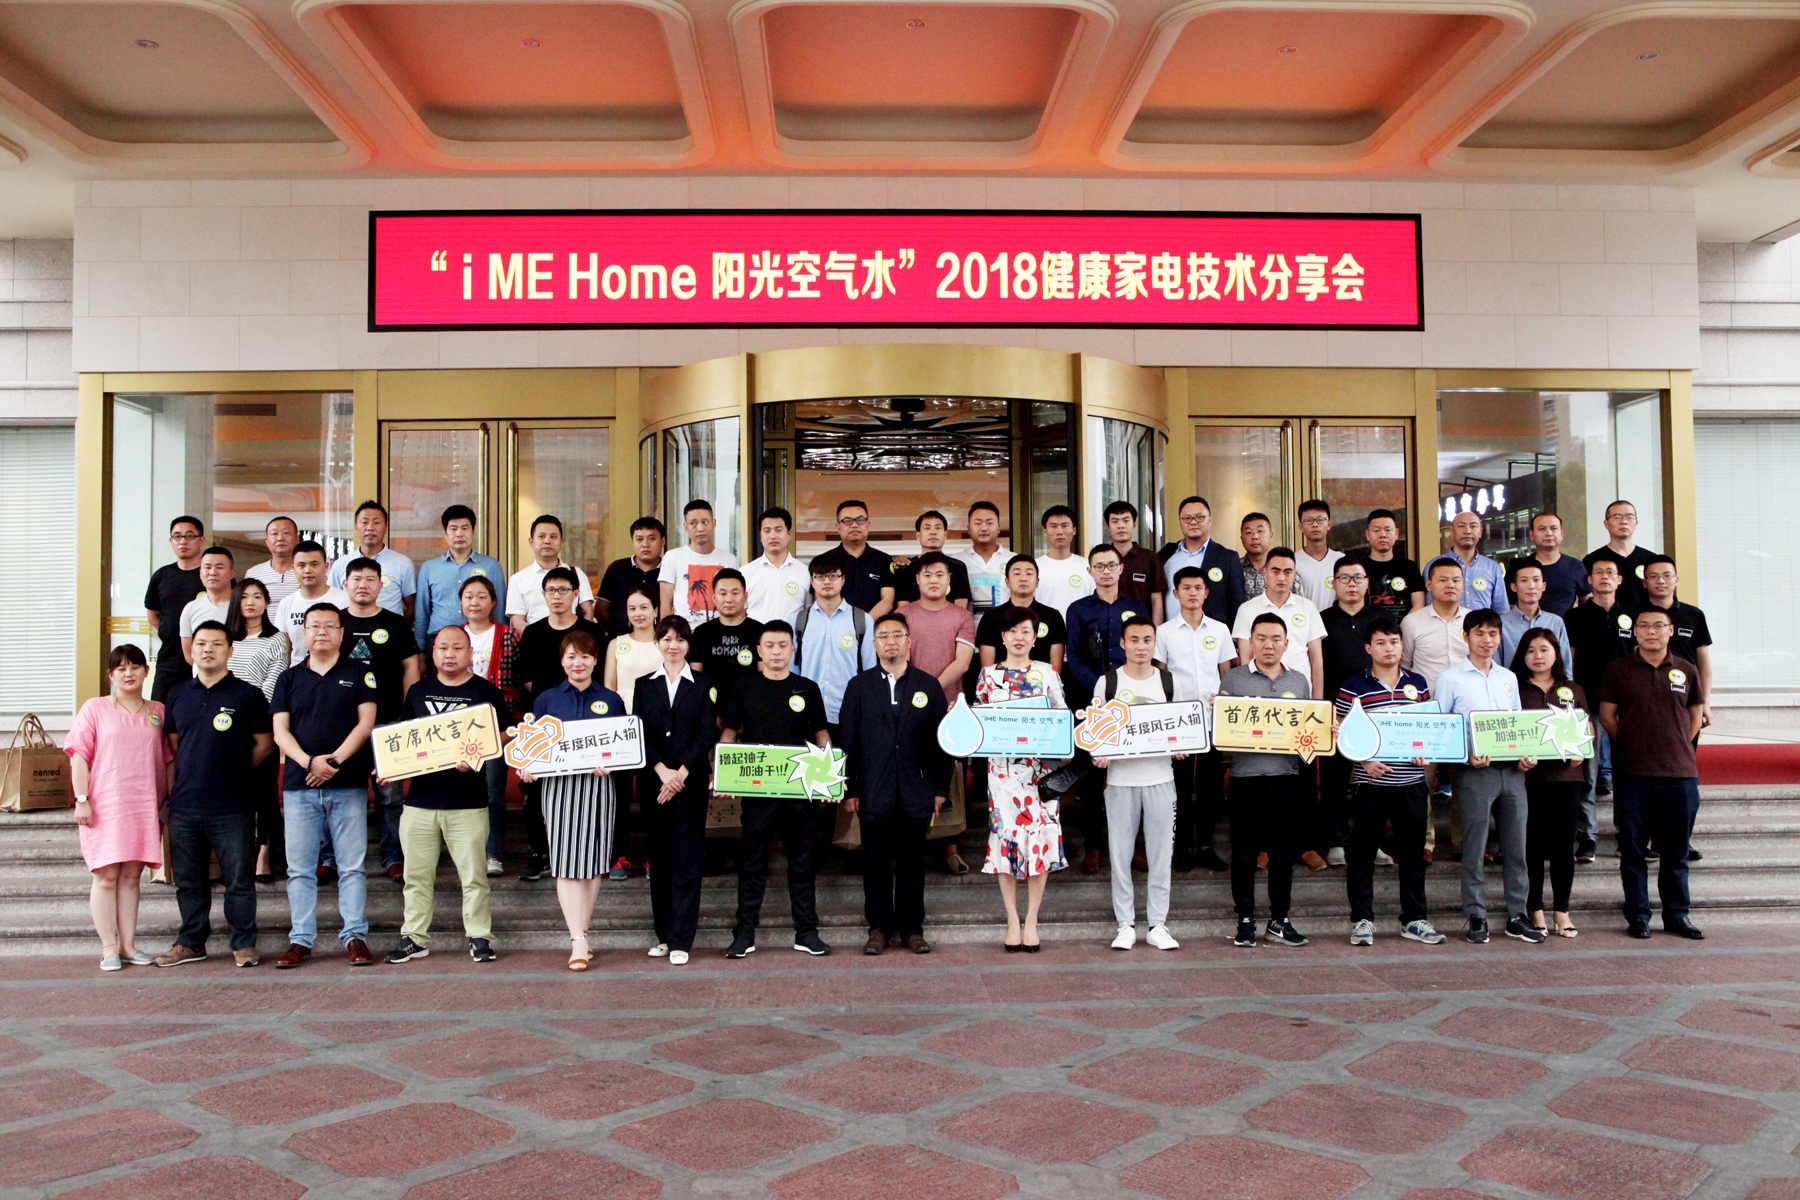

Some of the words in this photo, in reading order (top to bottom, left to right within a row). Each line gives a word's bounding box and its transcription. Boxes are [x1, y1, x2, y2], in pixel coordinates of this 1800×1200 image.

[488, 253, 554, 300] ME
[569, 253, 697, 300] Home
[1125, 713, 1202, 737] 年度风云人物
[1224, 705, 1325, 727] 首席代言人
[384, 718, 486, 753] 首席代言人
[558, 727, 638, 753] 年度风云人物
